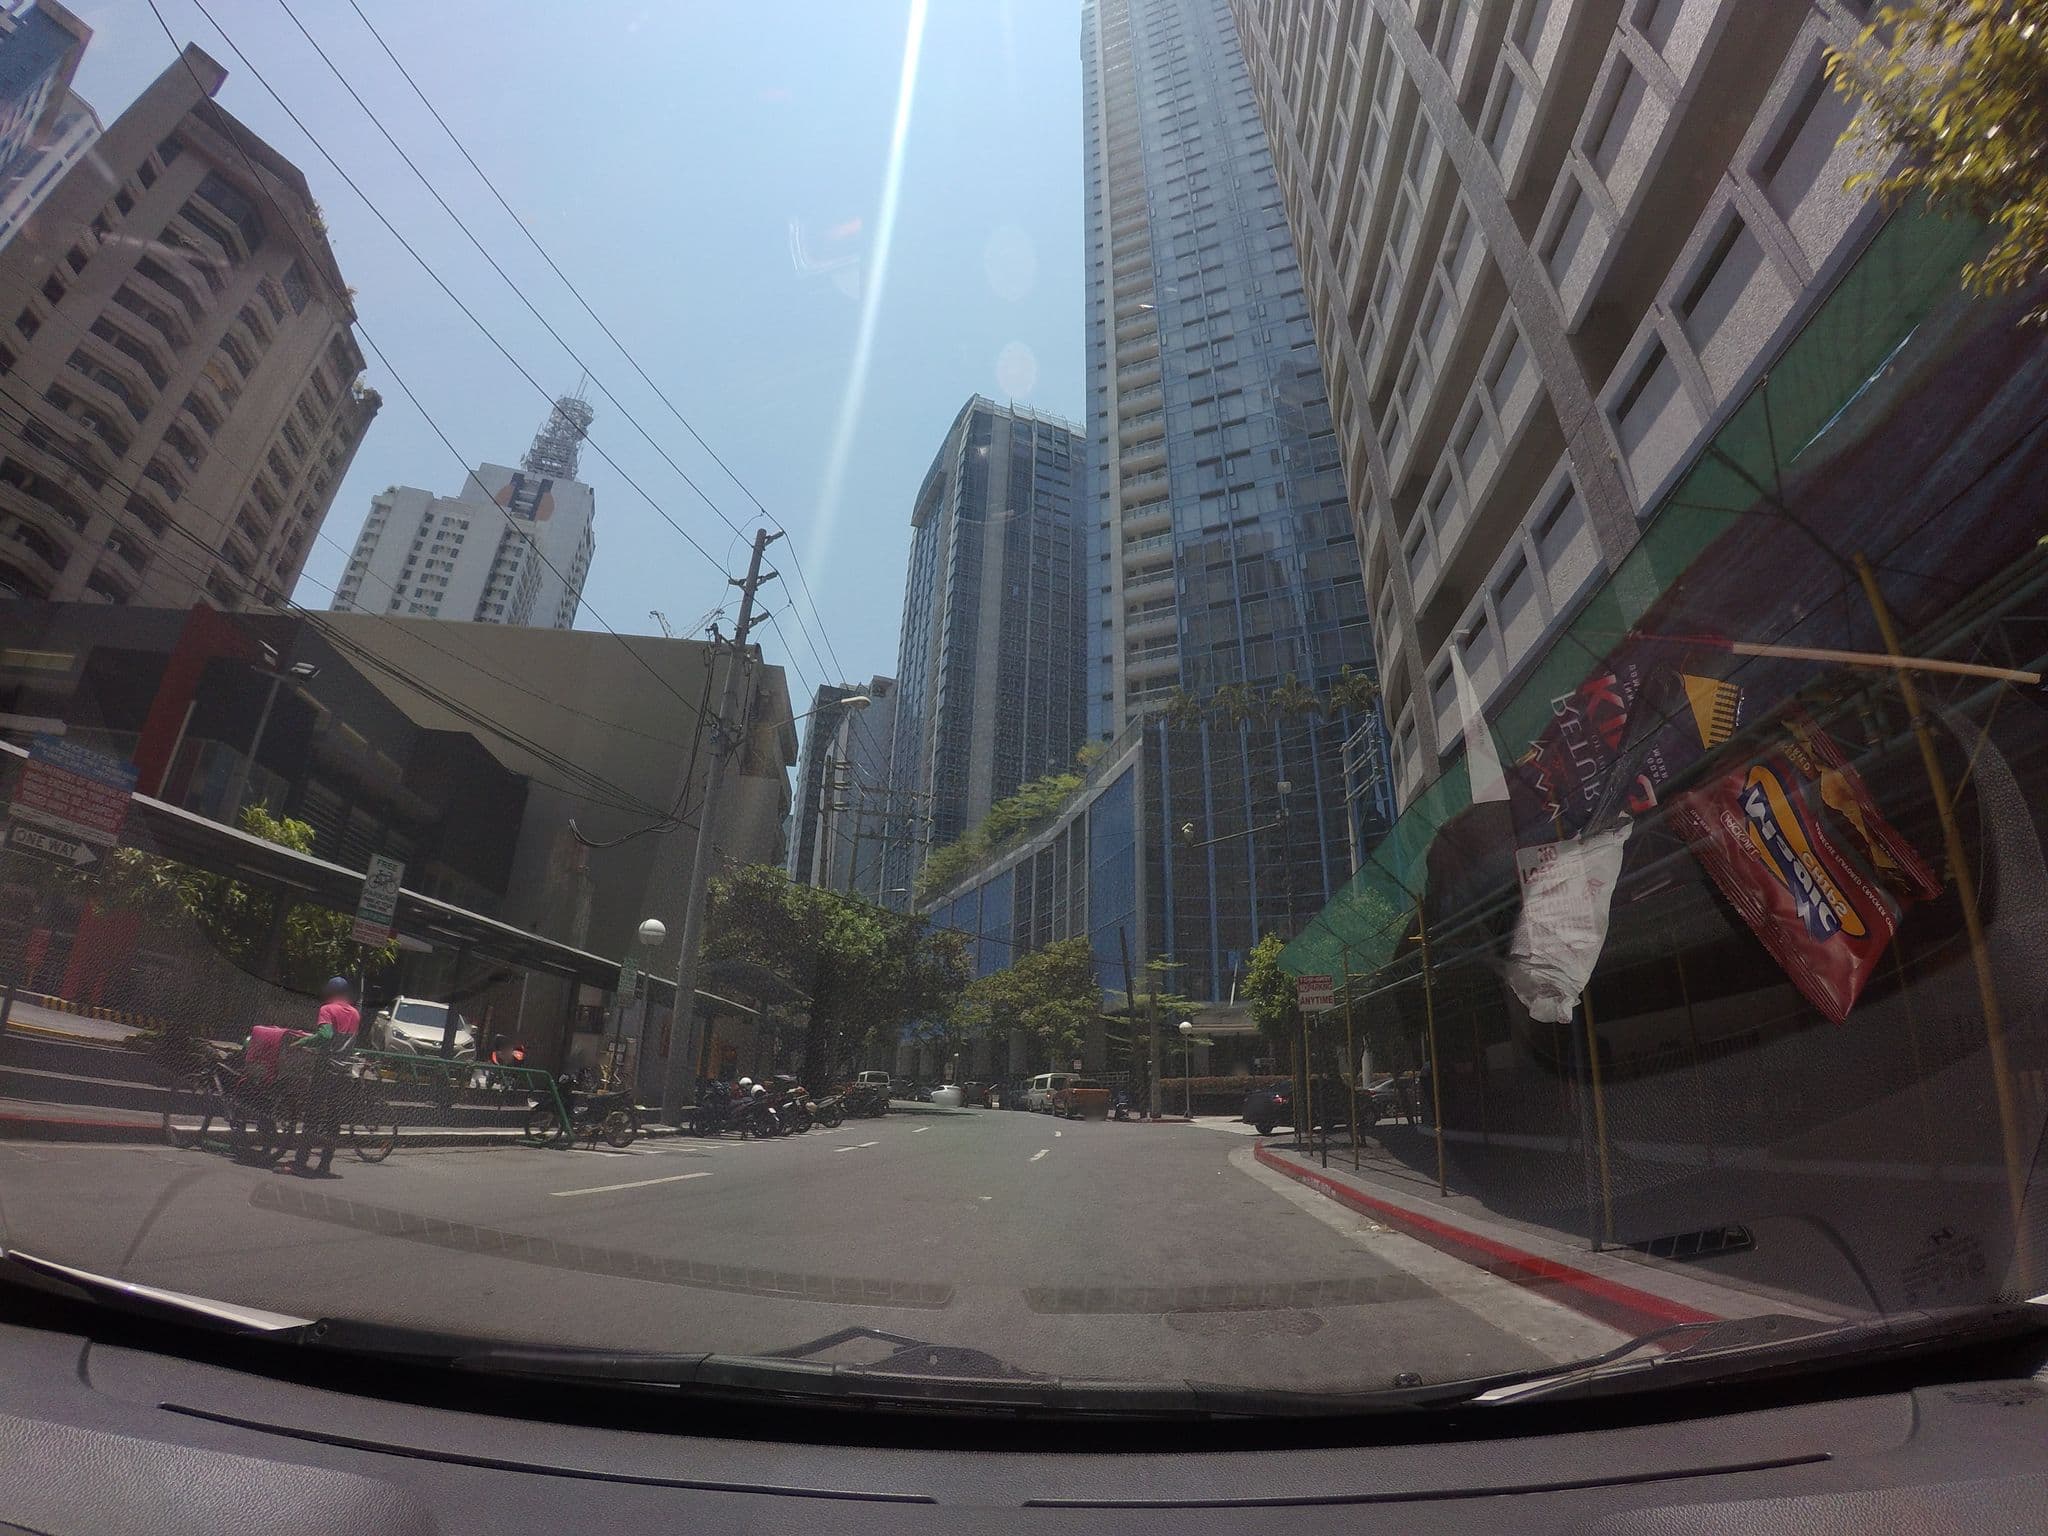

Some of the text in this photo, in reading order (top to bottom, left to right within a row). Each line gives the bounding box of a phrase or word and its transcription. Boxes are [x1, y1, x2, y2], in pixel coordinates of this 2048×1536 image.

[15, 828, 77, 857] ONE WAY
[1300, 996, 1333, 1005] ANYTIME
